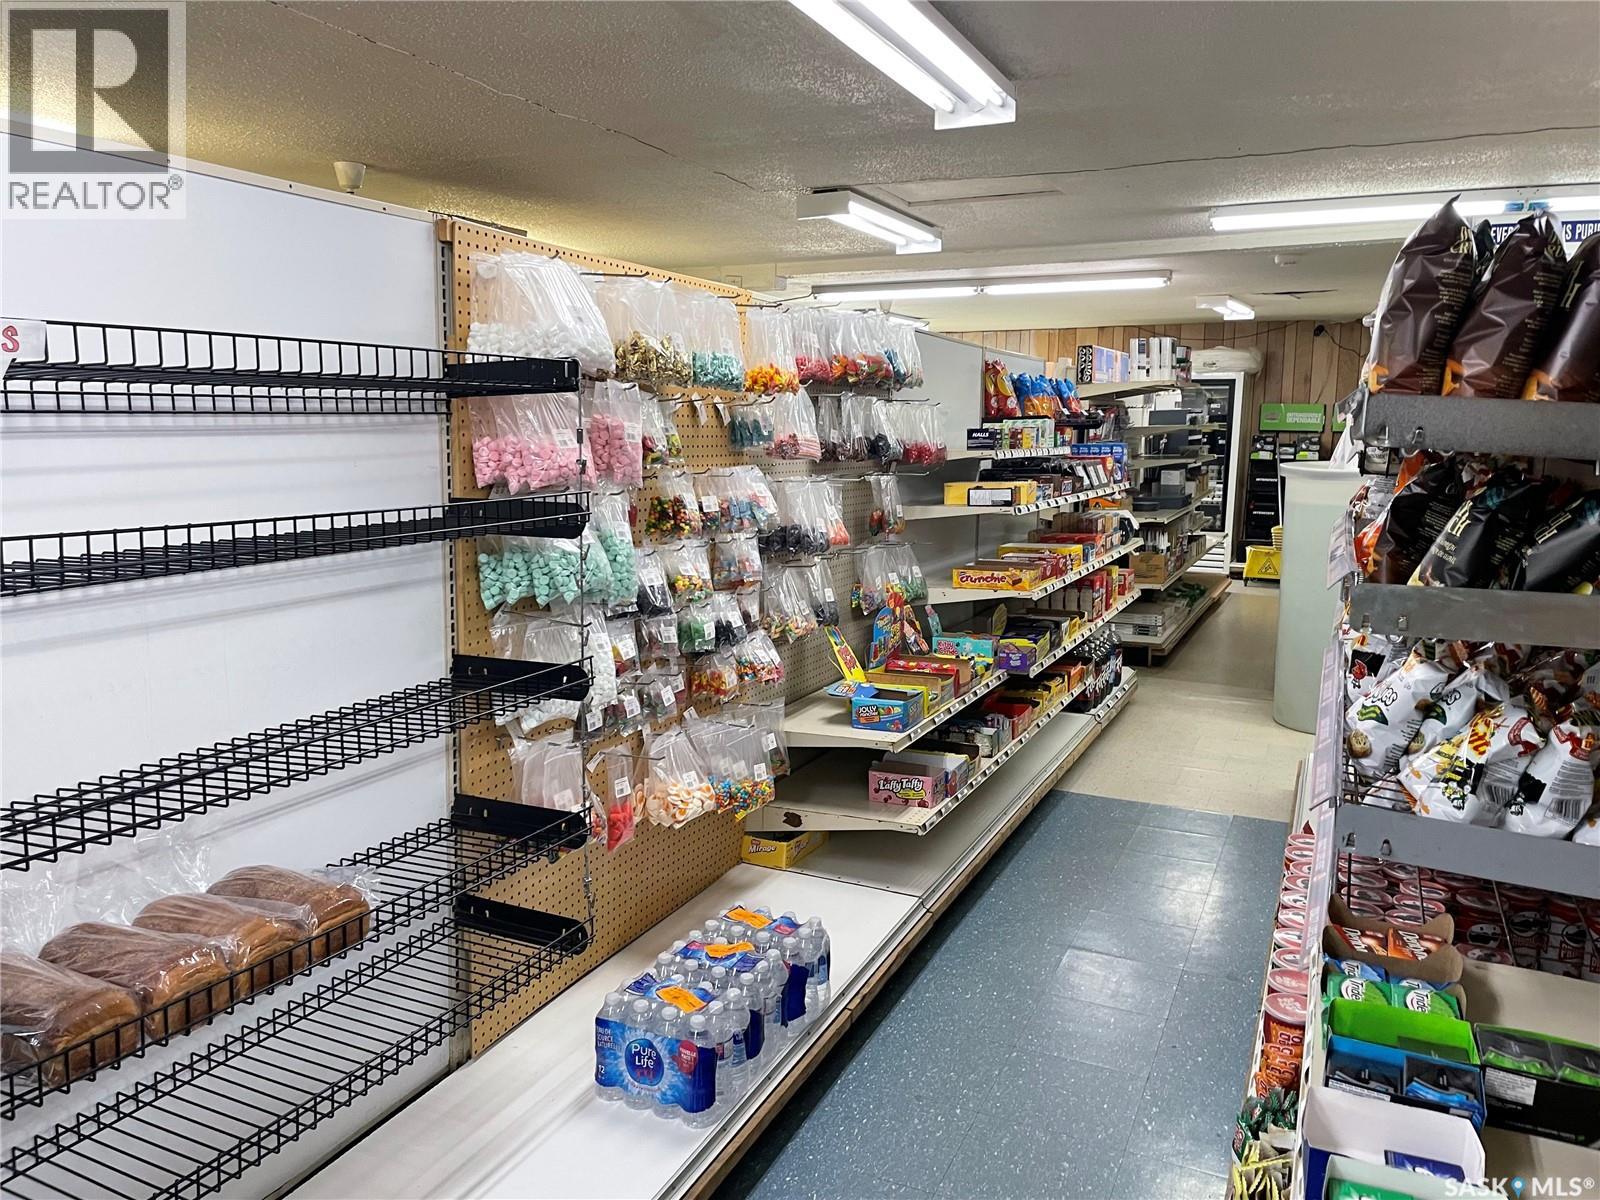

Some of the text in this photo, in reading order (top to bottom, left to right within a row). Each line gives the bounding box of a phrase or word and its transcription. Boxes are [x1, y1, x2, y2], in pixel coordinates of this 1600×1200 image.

[2, 325, 20, 352] S
[859, 705, 877, 713] JOLLY
[879, 778, 923, 792] Laffy Taffy
[631, 1043, 657, 1060] Pure
[635, 1056, 654, 1068] Life
